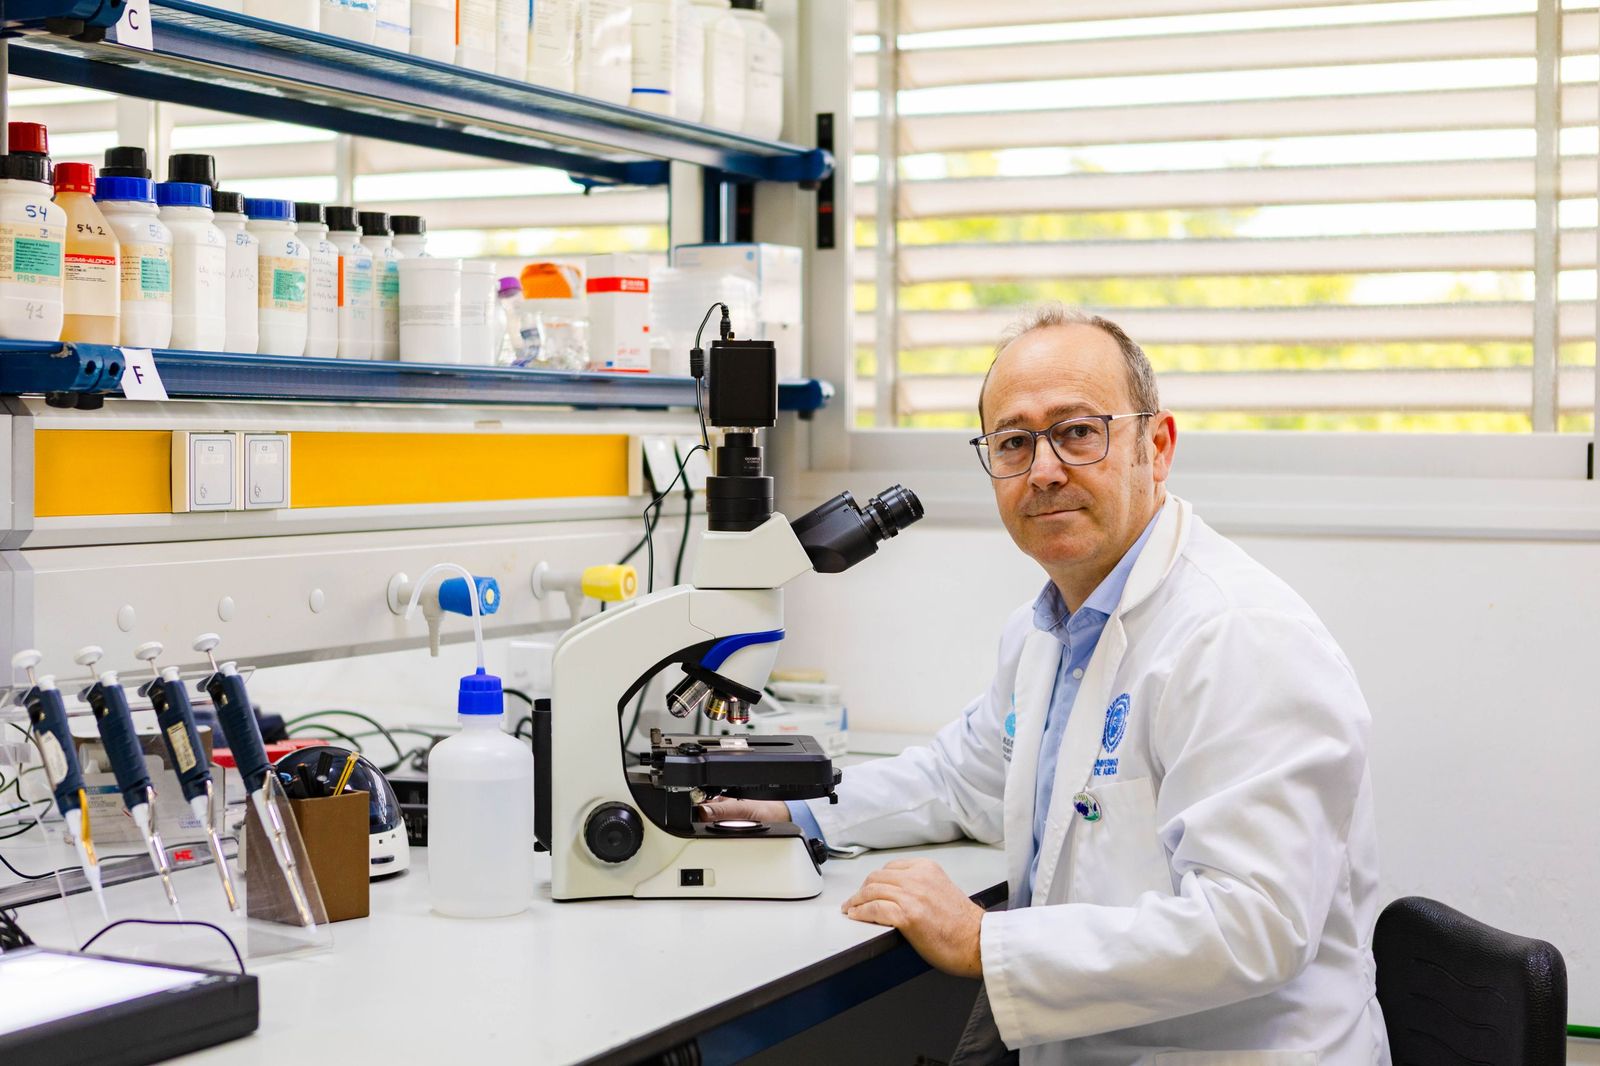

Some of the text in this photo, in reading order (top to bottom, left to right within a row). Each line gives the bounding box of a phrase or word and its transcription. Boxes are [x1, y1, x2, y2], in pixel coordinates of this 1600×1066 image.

[128, 8, 139, 30] C
[25, 204, 48, 221] 54
[16, 273, 37, 284] PRS
[132, 365, 144, 385] F
